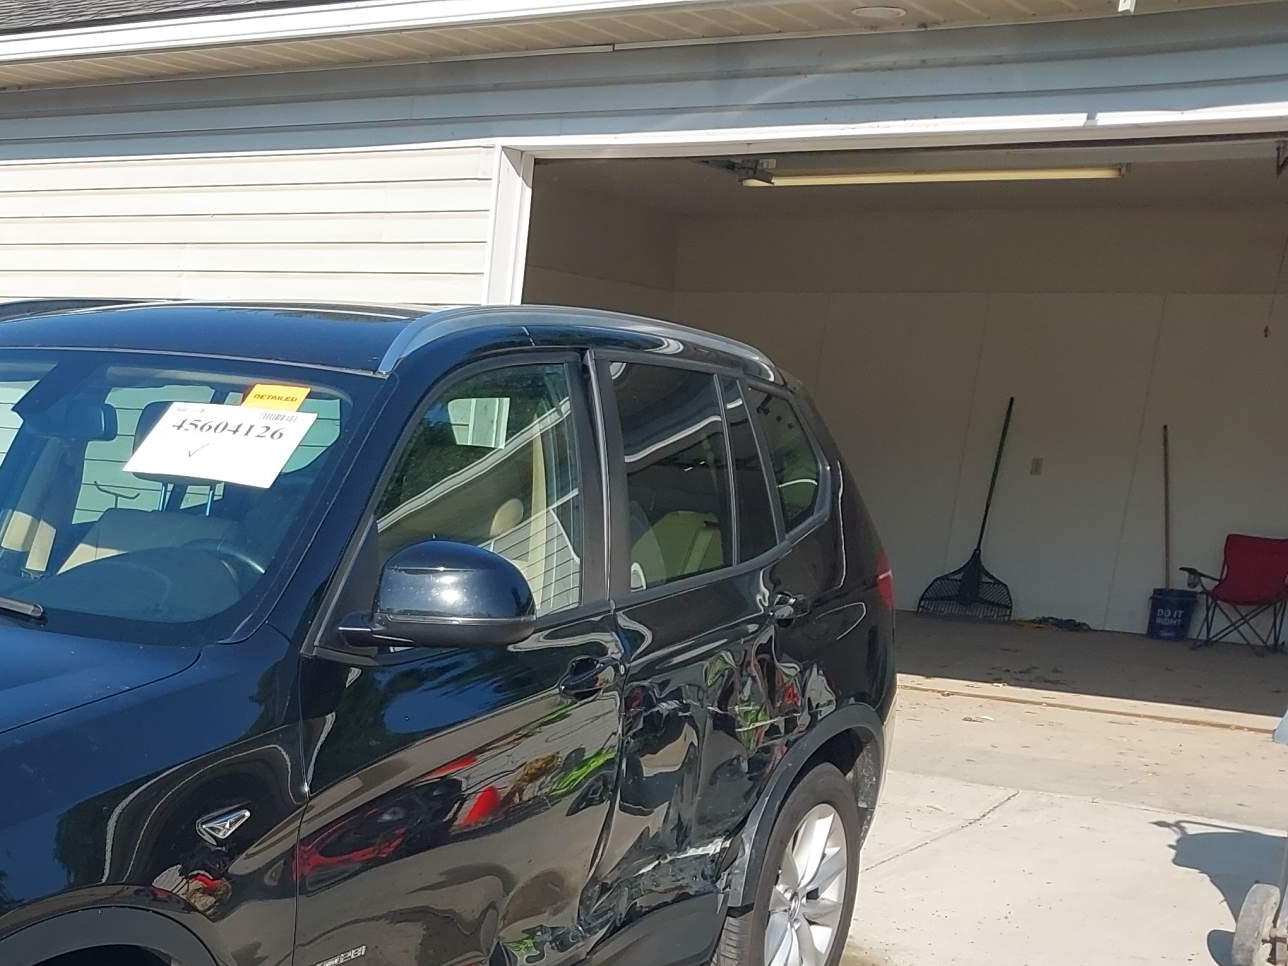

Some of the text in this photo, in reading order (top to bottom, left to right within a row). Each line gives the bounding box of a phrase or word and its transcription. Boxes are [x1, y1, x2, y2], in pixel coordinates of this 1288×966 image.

[252, 393, 299, 403] DETAILED
[171, 417, 285, 441] 45604126
[1157, 608, 1185, 618] DO IT
